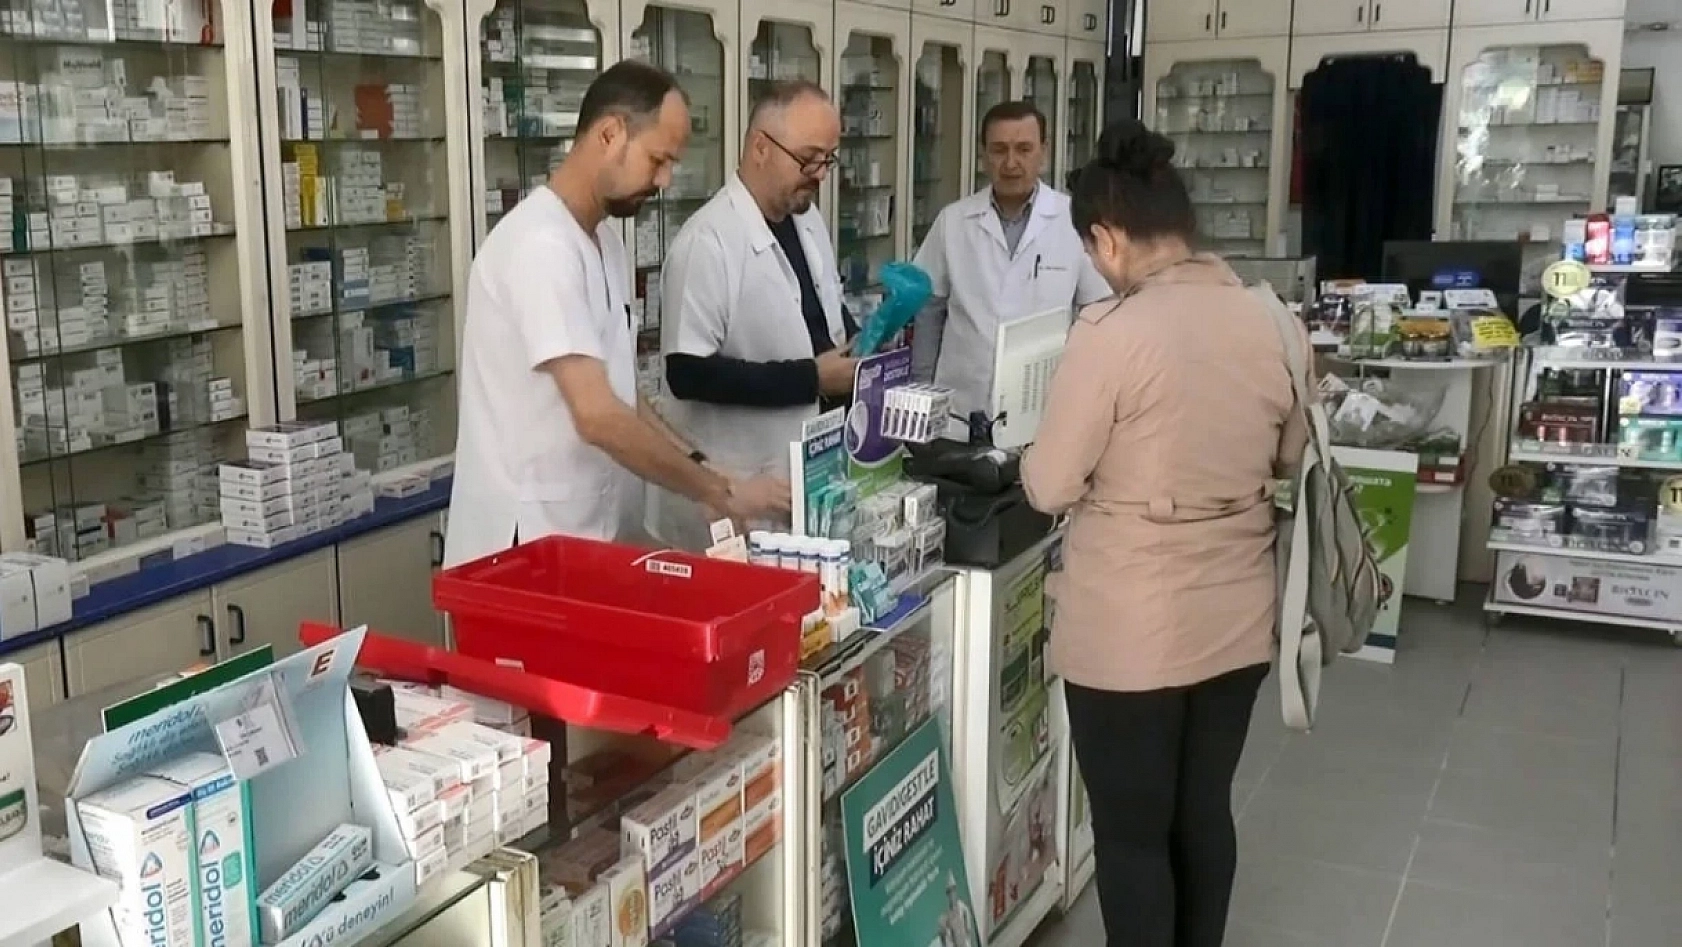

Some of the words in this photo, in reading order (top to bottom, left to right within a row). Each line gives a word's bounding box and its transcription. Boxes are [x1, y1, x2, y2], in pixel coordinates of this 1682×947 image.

[311, 650, 334, 676] E
[903, 795, 935, 845] RAHAT
[284, 864, 336, 930] meridol
[339, 886, 395, 935] deneyin!
